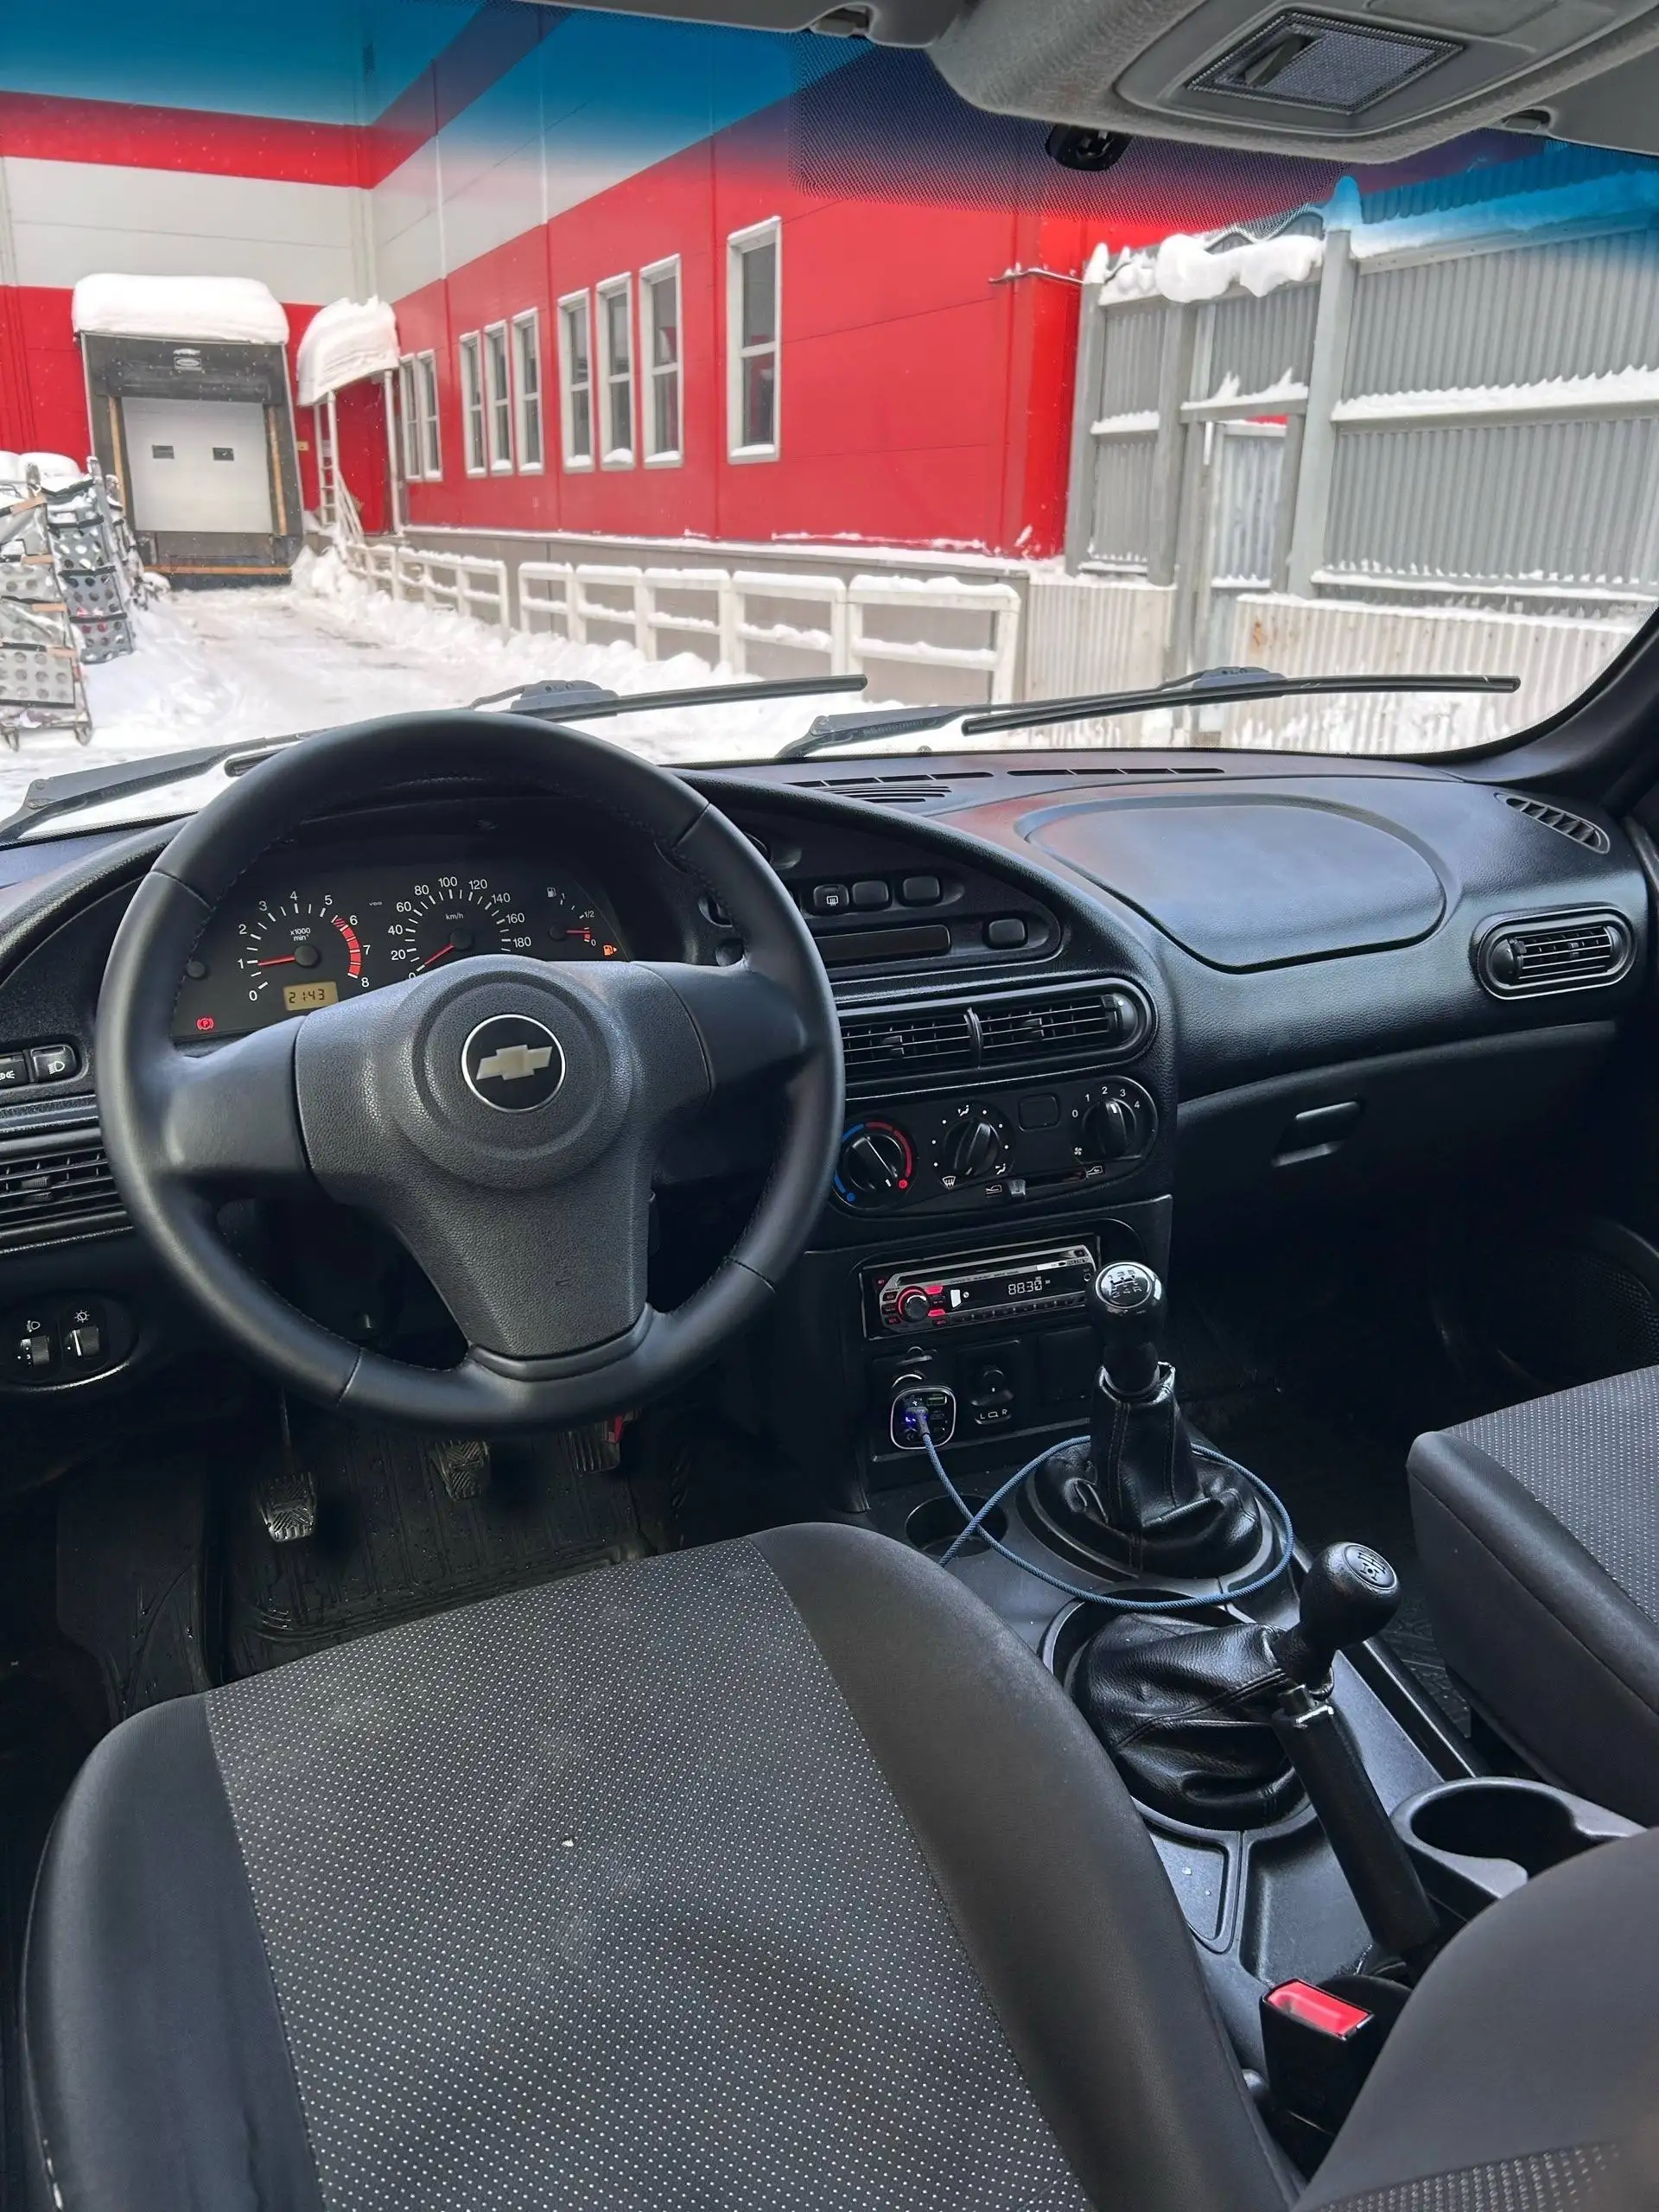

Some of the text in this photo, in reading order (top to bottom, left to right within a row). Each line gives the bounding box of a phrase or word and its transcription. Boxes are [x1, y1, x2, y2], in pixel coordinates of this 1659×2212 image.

[437, 876, 458, 887] 100
[468, 879, 487, 890] 120
[414, 884, 429, 896] 80
[289, 891, 298, 901] 4
[324, 894, 333, 906] 5
[491, 892, 511, 904] 140
[259, 900, 268, 912] 3
[396, 901, 412, 912] 60
[349, 915, 358, 925] 6
[505, 912, 525, 924] 160
[238, 924, 247, 935] 2
[388, 924, 404, 936] 40
[512, 937, 531, 948] 180
[363, 944, 371, 956] 7
[391, 949, 406, 961] 20
[238, 959, 244, 969] 1
[361, 977, 370, 988] 8
[249, 990, 258, 1001] 0
[1102, 1086, 1108, 1095] 2
[1120, 1089, 1126, 1097] 3
[1084, 1093, 1090, 1102] 1
[1071, 1109, 1078, 1118] 0
